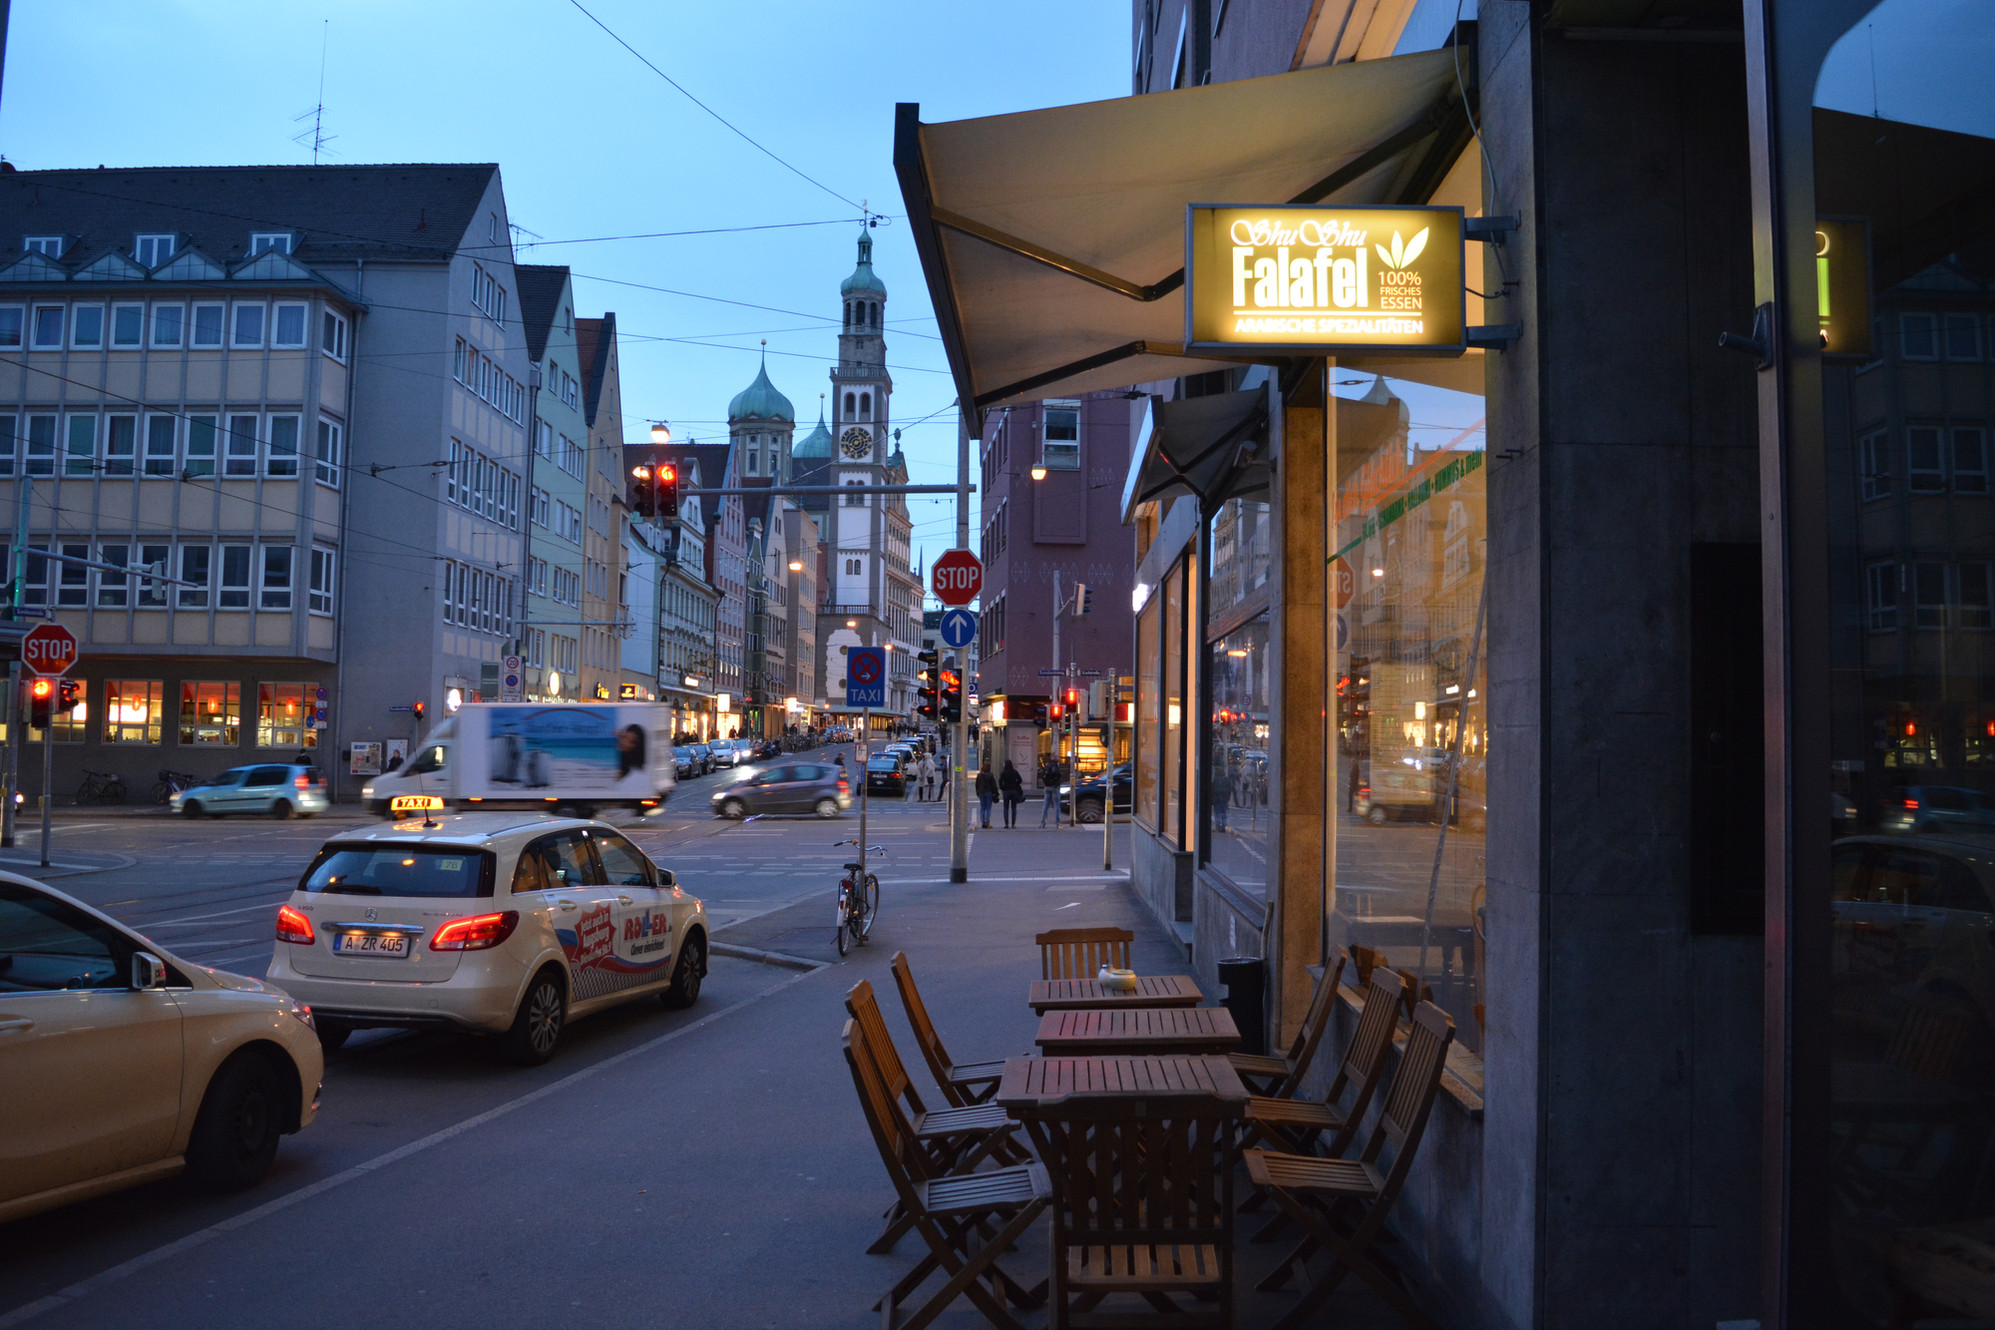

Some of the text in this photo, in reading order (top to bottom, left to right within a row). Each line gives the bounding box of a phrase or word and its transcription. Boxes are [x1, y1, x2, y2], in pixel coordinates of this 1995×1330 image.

[1230, 219, 1367, 247] Shu Shu
[1232, 247, 1368, 308] Falafel
[1378, 271, 1422, 286] 100%
[1380, 287, 1422, 296] FRISCHES
[1380, 297, 1423, 309] ESSEN
[1235, 318, 1424, 334] ARABISCHE SPEZIALITÄTEN
[936, 566, 979, 590] STOP
[27, 639, 73, 660] STOP
[850, 689, 881, 702] TAXI
[400, 798, 429, 808] TAXI
[446, 861, 459, 870] 76
[624, 908, 667, 941] ROLLER
[345, 936, 403, 952] A ZR 405
[583, 926, 610, 949] Augsburg
